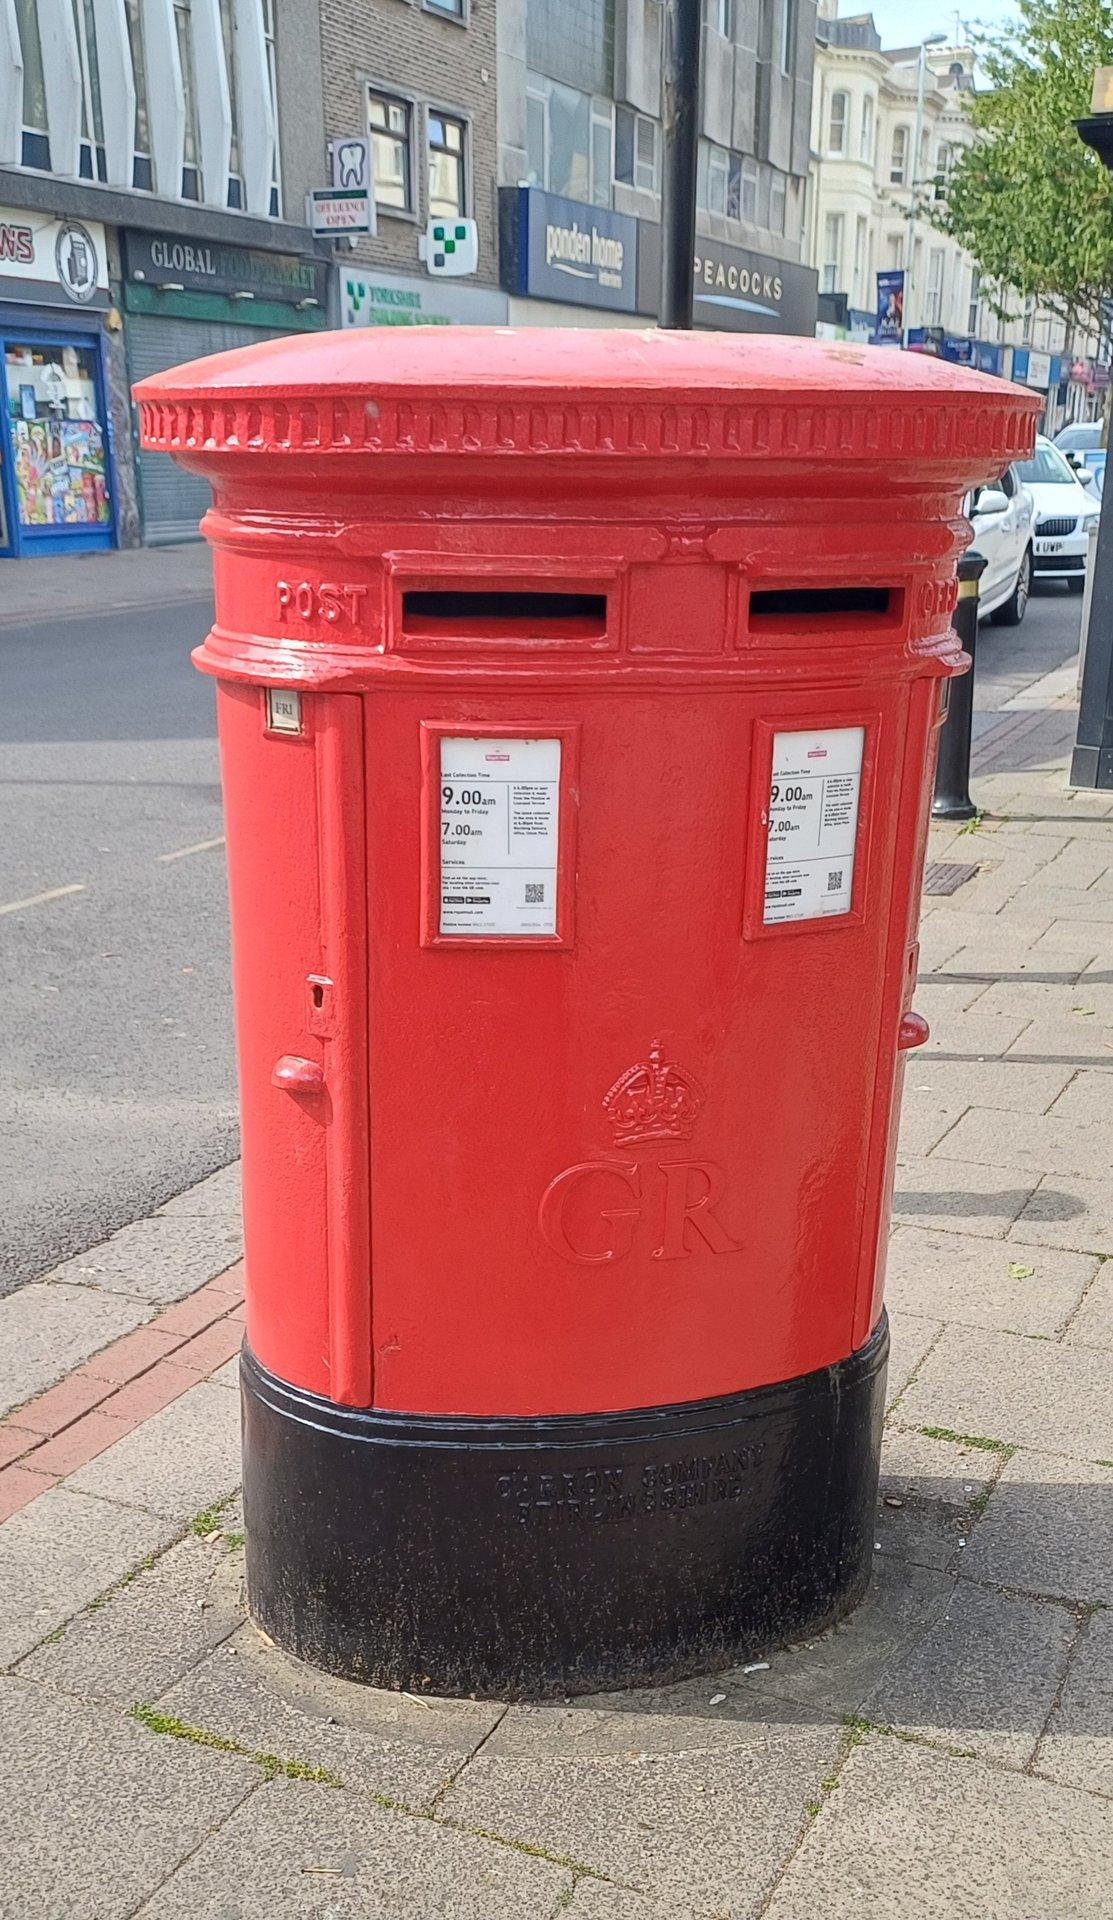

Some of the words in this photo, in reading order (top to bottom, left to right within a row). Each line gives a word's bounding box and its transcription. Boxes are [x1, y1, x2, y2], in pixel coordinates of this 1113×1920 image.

[546, 222, 590, 266] ponden
[592, 226, 623, 271] home
[151, 240, 216, 275] GLOBAL
[369, 286, 421, 309] YORKSHIRE
[276, 580, 367, 624] POST
[275, 702, 293, 715] FRI
[442, 786, 496, 806] 9.00am
[771, 785, 813, 803] 9.00am
[442, 822, 483, 837] 7.00am
[768, 820, 800, 833] 7.00am
